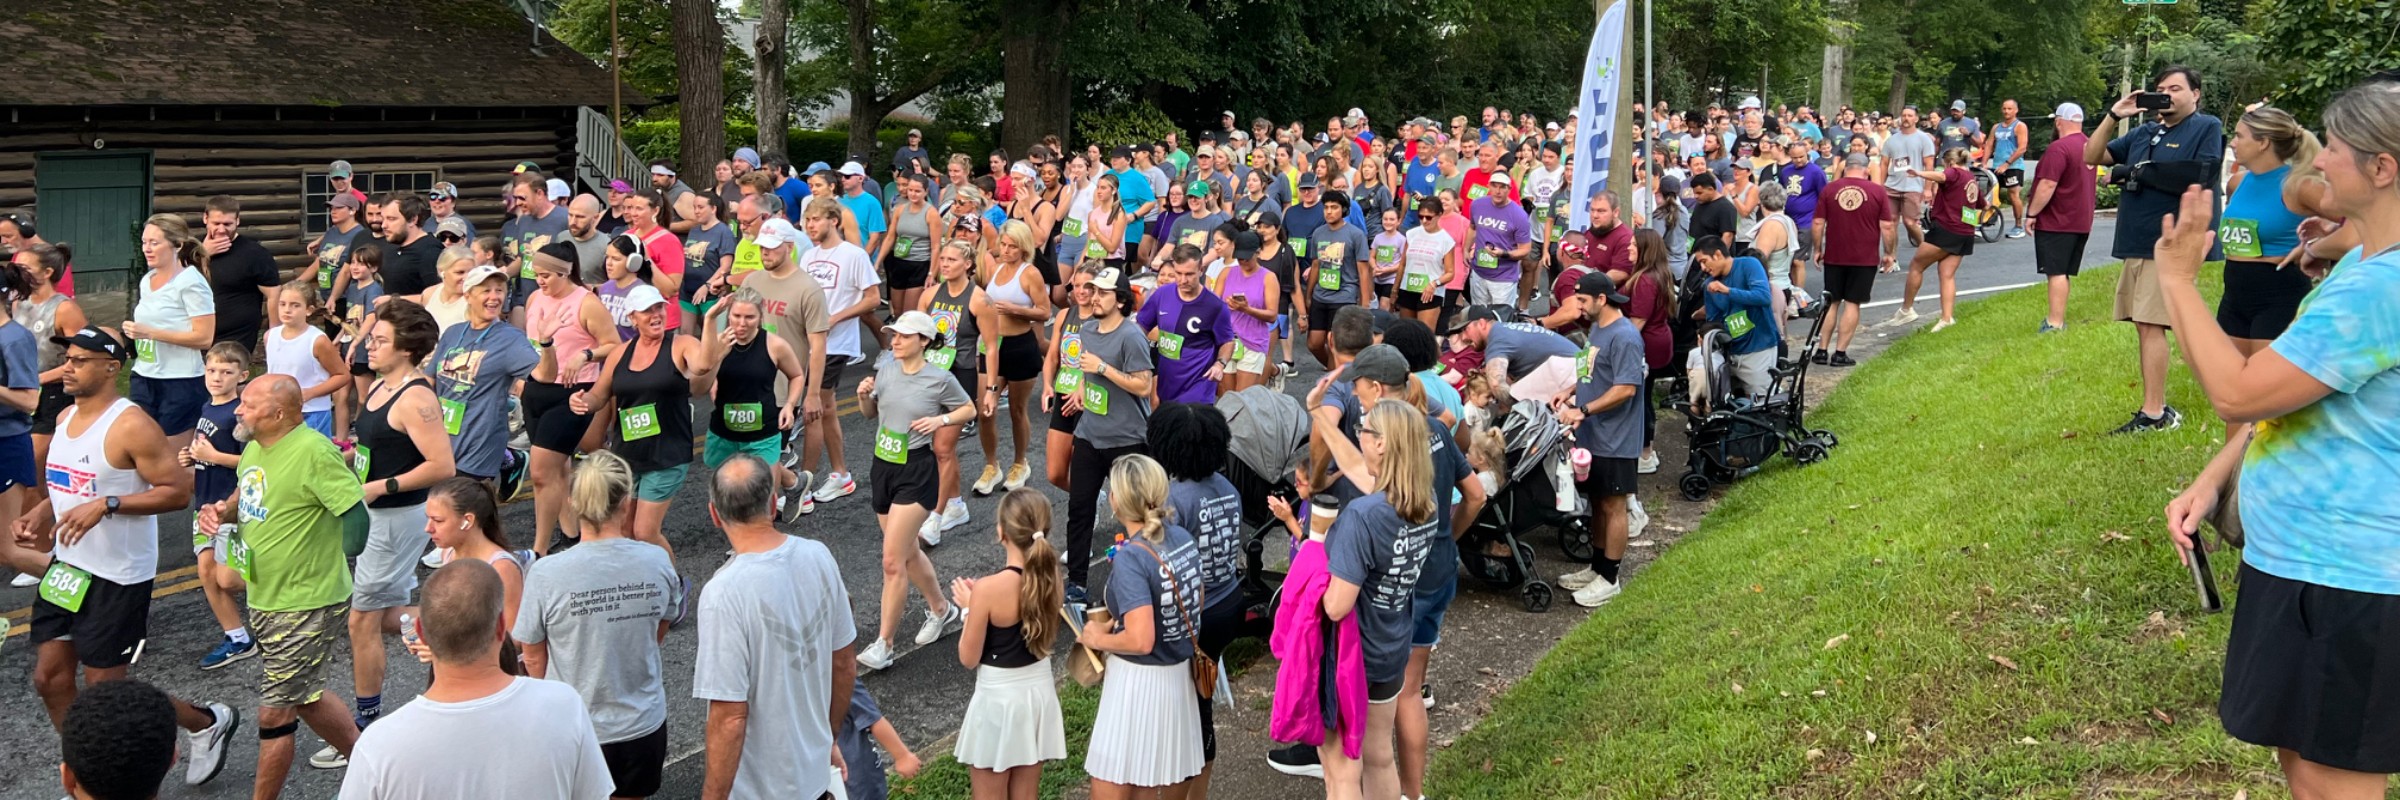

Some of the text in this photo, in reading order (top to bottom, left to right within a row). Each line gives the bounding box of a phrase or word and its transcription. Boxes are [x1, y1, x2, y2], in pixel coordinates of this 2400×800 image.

[1477, 215, 1508, 232] LOVE.
[2221, 226, 2252, 244] 245
[1321, 272, 1337, 283] 242
[1409, 277, 1425, 287] 607
[1186, 316, 1202, 333] C
[1729, 315, 1746, 330] 114
[1159, 336, 1178, 352] 806
[1057, 373, 1078, 387] 864
[1086, 387, 1102, 405] 182
[624, 412, 652, 430] 159
[728, 410, 756, 424] 780
[880, 433, 903, 454] 283
[48, 568, 83, 595] 584
[570, 591, 589, 600] Dear
[591, 587, 617, 598] person
[618, 582, 644, 592] behind
[570, 600, 584, 608] the
[585, 595, 607, 605] world
[622, 592, 644, 600] better
[570, 608, 588, 616] with
[589, 606, 604, 616] you
[614, 602, 620, 611] it
